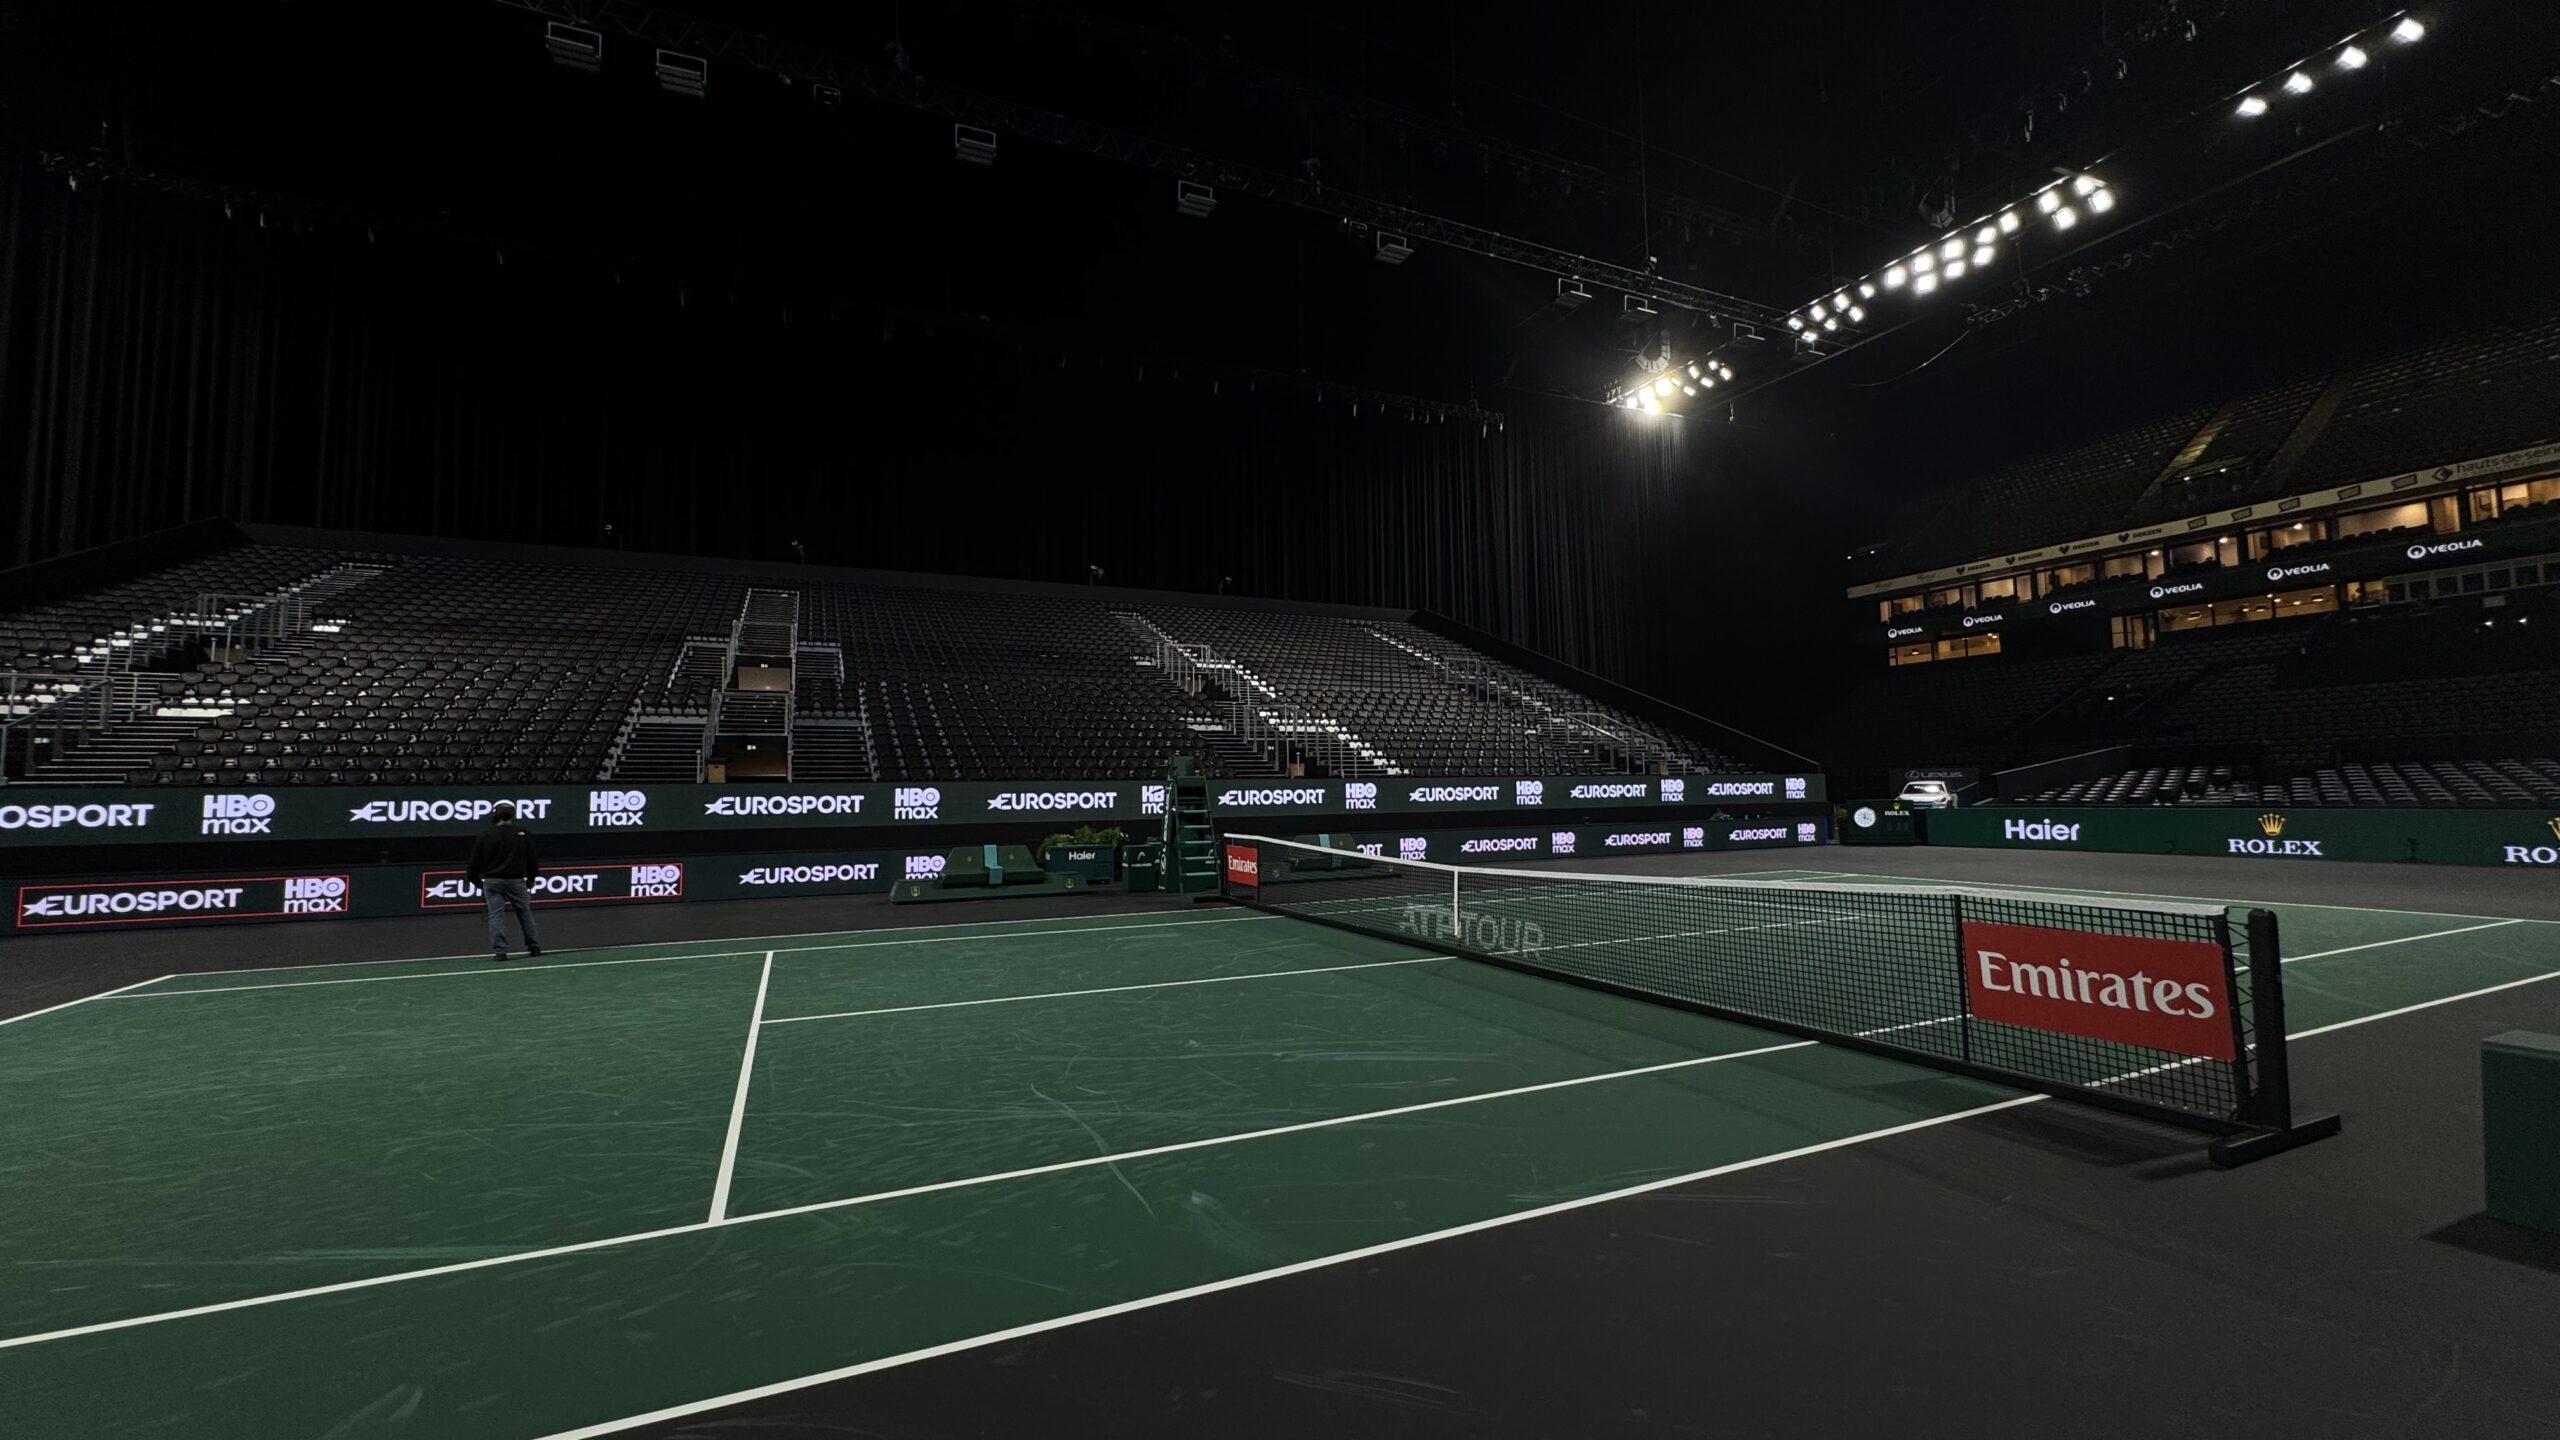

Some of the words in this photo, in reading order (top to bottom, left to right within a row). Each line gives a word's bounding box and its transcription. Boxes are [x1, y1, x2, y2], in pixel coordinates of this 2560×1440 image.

[2427, 539, 2483, 554] VEOLIA
[2284, 563, 2330, 576] VEOLIA
[2164, 582, 2203, 595] VEOLIA
[2062, 600, 2096, 610] VEOLIA
[1974, 614, 2003, 624] VEOLIA
[1897, 626, 1923, 635] VEOLIA
[1346, 783, 1377, 799] HBO
[1516, 780, 1543, 795] HBO
[1570, 784, 1647, 798] EUROSPORT
[1661, 779, 1685, 792] HBO
[1707, 782, 1774, 796] EUROSPORT
[1785, 778, 1806, 789] HBO
[590, 790, 646, 812] HBO
[895, 788, 940, 806] HBO
[987, 792, 1117, 810] EUROSPORT
[1217, 789, 1325, 805] EUROSPORT
[1409, 787, 1499, 802] EUROSPORT
[1516, 795, 1543, 805] max
[1661, 791, 1684, 802] max
[1785, 789, 1806, 799] max
[203, 794, 275, 818] HBO
[350, 800, 551, 822] EUROSPRT
[704, 795, 864, 815] EUROSPORT
[1346, 798, 1376, 809] max
[589, 812, 644, 826] max
[895, 806, 938, 819] max
[202, 817, 272, 834] max
[1683, 827, 1704, 838] HBO
[1797, 823, 1816, 833] HBO
[2004, 818, 2080, 841] Haier
[1552, 832, 1576, 844] HBO
[1604, 832, 1671, 847] EUROSPORT
[1728, 827, 1787, 841] EUROSPORT
[1797, 832, 1816, 842] max
[1400, 837, 1427, 852] HBO
[1460, 837, 1538, 853] EUROSPORT
[1552, 843, 1575, 853] max
[1683, 837, 1703, 848] max
[2227, 838, 2323, 856] ROLEX
[1068, 850, 1096, 861] Haier
[1400, 851, 1425, 860] max
[2503, 846, 2560, 864] RO
[906, 855, 946, 873] HBO
[1227, 855, 1258, 875] Emirates
[631, 865, 680, 885] HBO
[739, 864, 879, 885] EUROSPORT
[285, 877, 346, 899] HBO
[630, 883, 678, 897] max
[23, 888, 244, 917] EUROSPORT
[284, 898, 343, 913] max
[1400, 903, 1454, 939] ATP
[1460, 912, 1544, 958] TOUR
[1977, 950, 2215, 1019] Emirates
